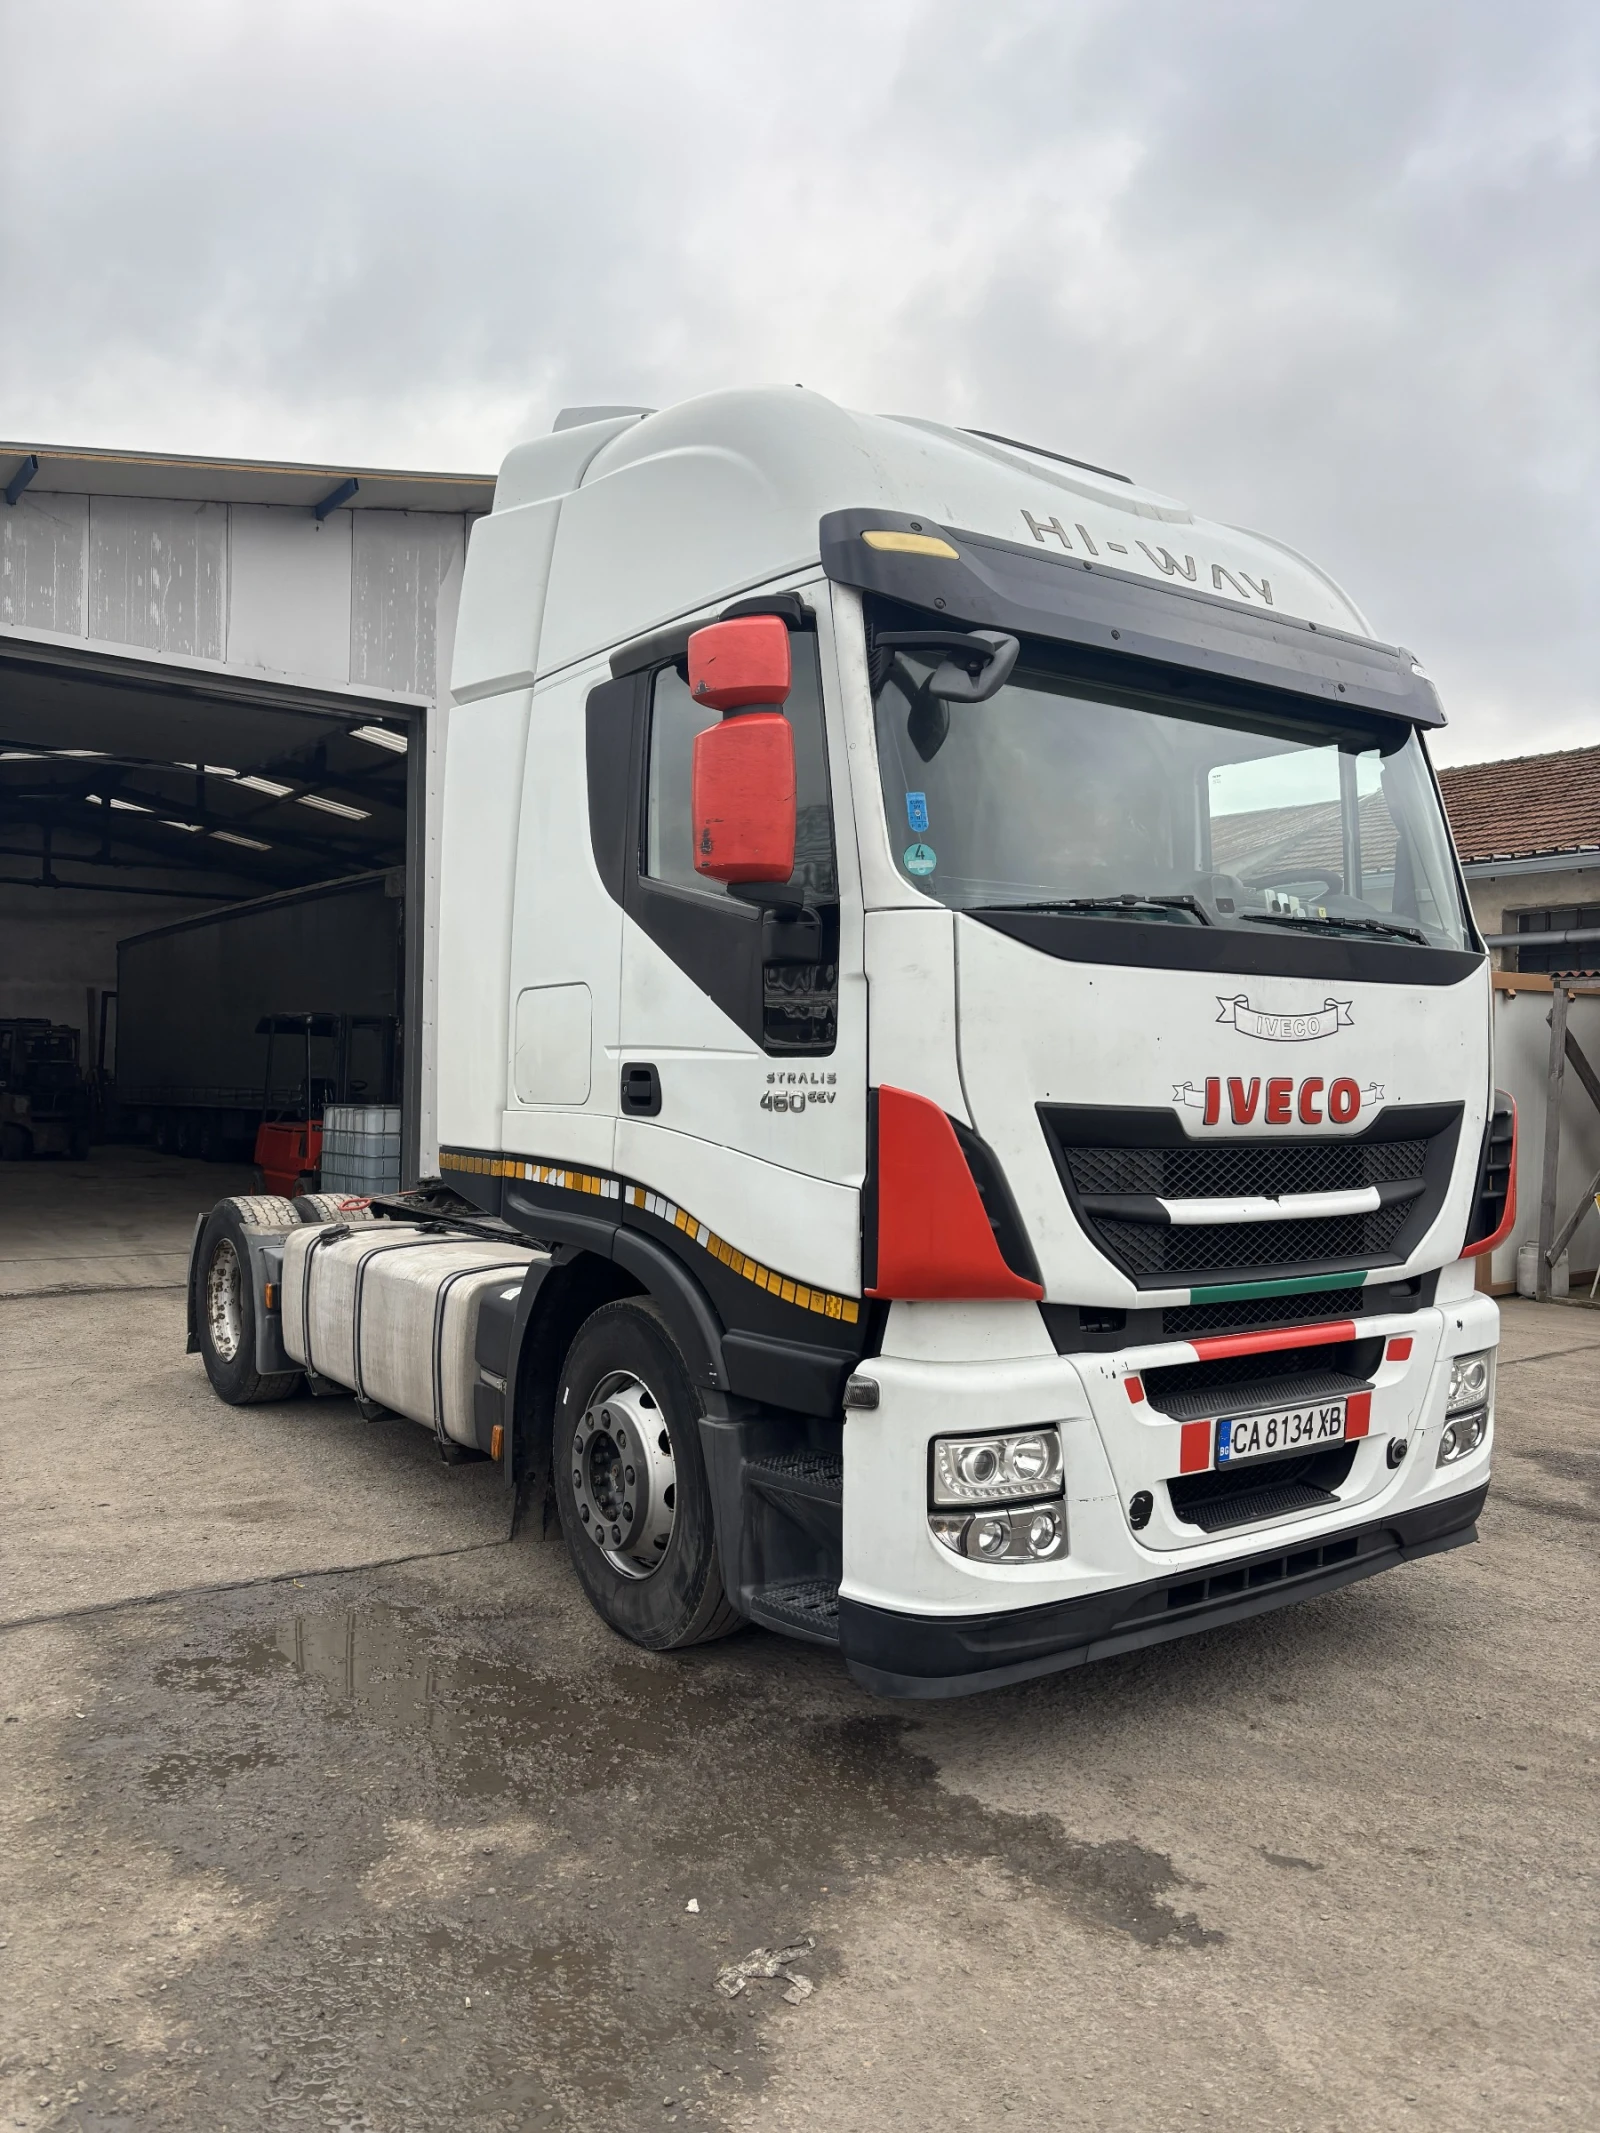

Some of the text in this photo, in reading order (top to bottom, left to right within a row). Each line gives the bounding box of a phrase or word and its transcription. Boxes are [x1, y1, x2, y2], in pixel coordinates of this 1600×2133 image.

[1020, 509, 1274, 605] HI-WAY
[915, 845, 925, 860] 4
[1256, 1016, 1320, 1038] IVECO
[766, 1072, 837, 1085] STRALIS
[759, 1090, 806, 1113] 460
[1202, 1076, 1361, 1125] IVECO
[1219, 1446, 1230, 1456] BG
